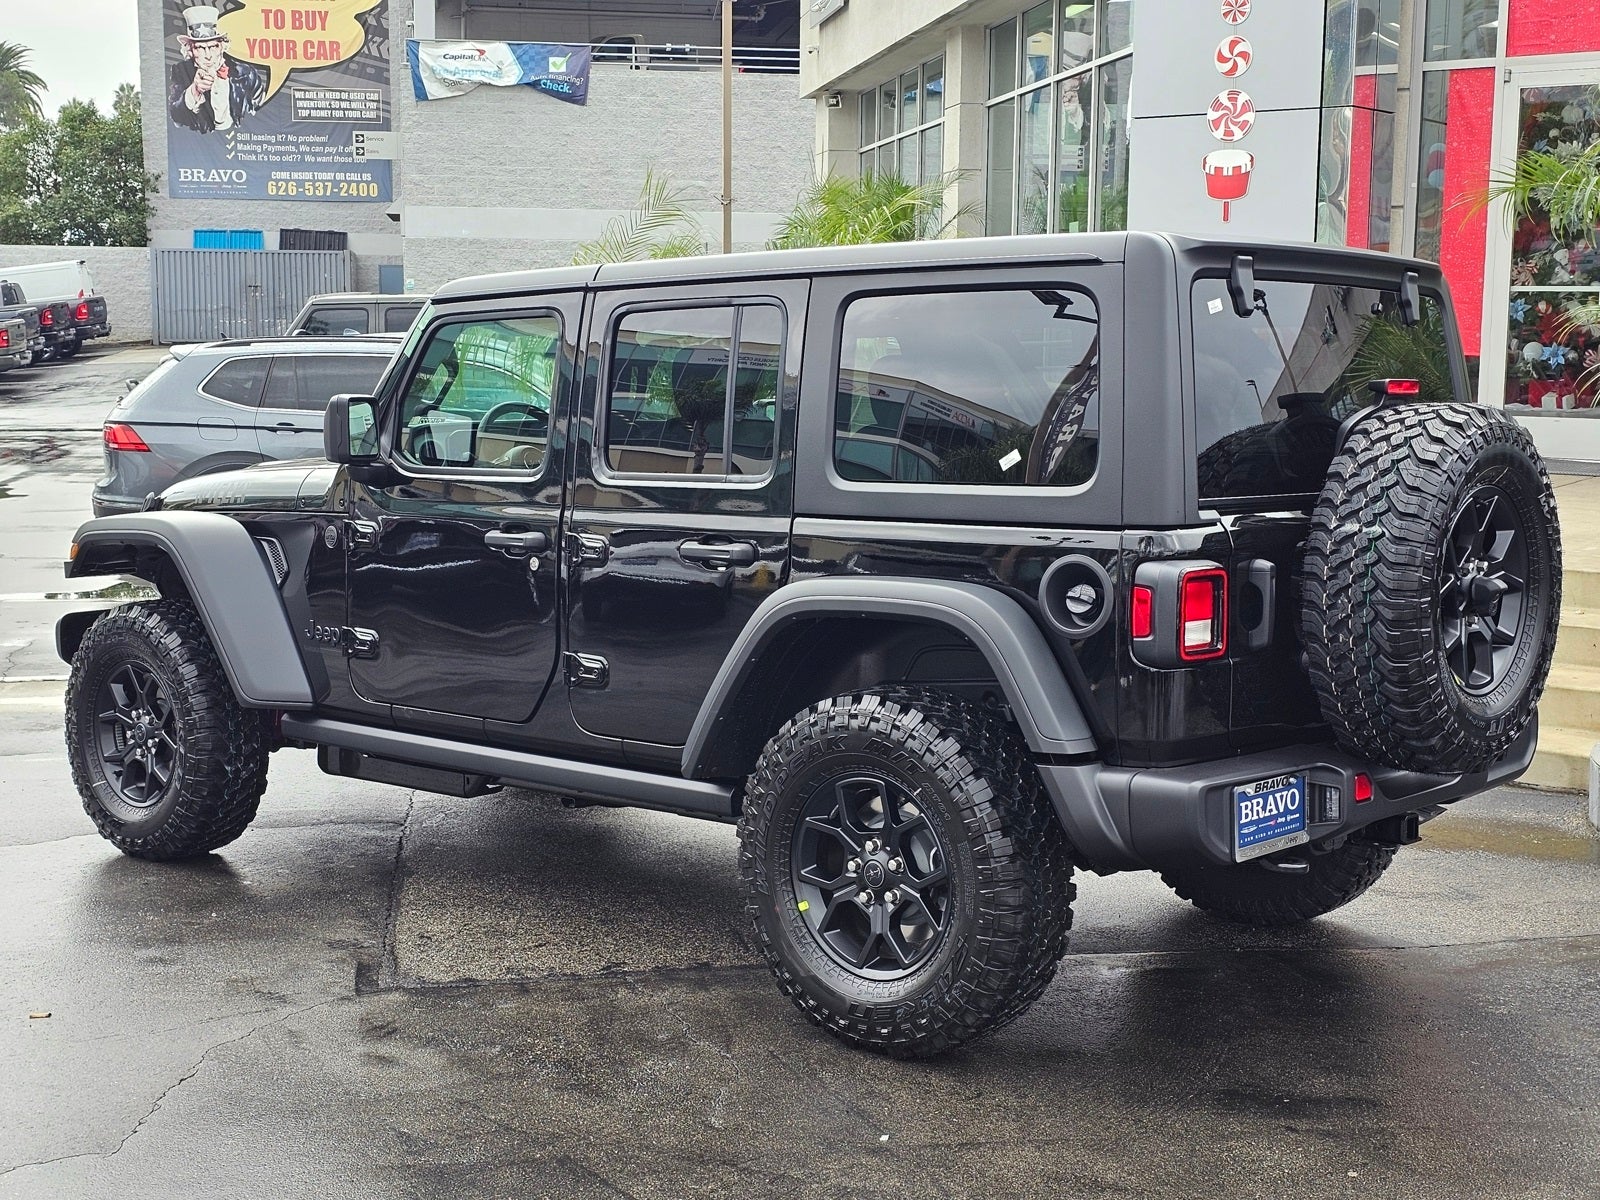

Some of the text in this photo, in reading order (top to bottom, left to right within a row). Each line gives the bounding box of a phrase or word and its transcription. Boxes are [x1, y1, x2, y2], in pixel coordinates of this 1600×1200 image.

[261, 9, 329, 31] TO BUY
[246, 38, 341, 60] YOUR CAR
[540, 79, 572, 93] Check.
[294, 91, 304, 99] WE
[305, 91, 317, 99] ARE
[317, 91, 325, 99] IN
[341, 92, 348, 100] OF
[350, 92, 365, 100] USED
[296, 100, 330, 109] INVENTORY,
[340, 101, 351, 109] WE
[351, 101, 366, 109] WILL
[298, 109, 310, 117] TOP
[311, 109, 331, 117] MONEY
[345, 110, 361, 118] YOUR
[237, 132, 250, 140] Still
[251, 133, 275, 143] leasing
[298, 134, 329, 144] problem!
[237, 143, 262, 152] Making
[262, 144, 298, 153] Payments,
[299, 144, 310, 152] We
[324, 146, 338, 154] pay
[237, 152, 257, 161] Think
[258, 153, 268, 161] it's
[281, 154, 301, 162] old??
[316, 155, 333, 163] want
[333, 155, 353, 163] those
[178, 168, 247, 183] BRAVO
[271, 171, 372, 181] COME INSIDE TODAY OR CALL US
[267, 180, 379, 197] 626-537-2400
[304, 619, 341, 648] Jeep
[1254, 775, 1292, 793] BRAVO
[1240, 788, 1300, 824] BRAVO
